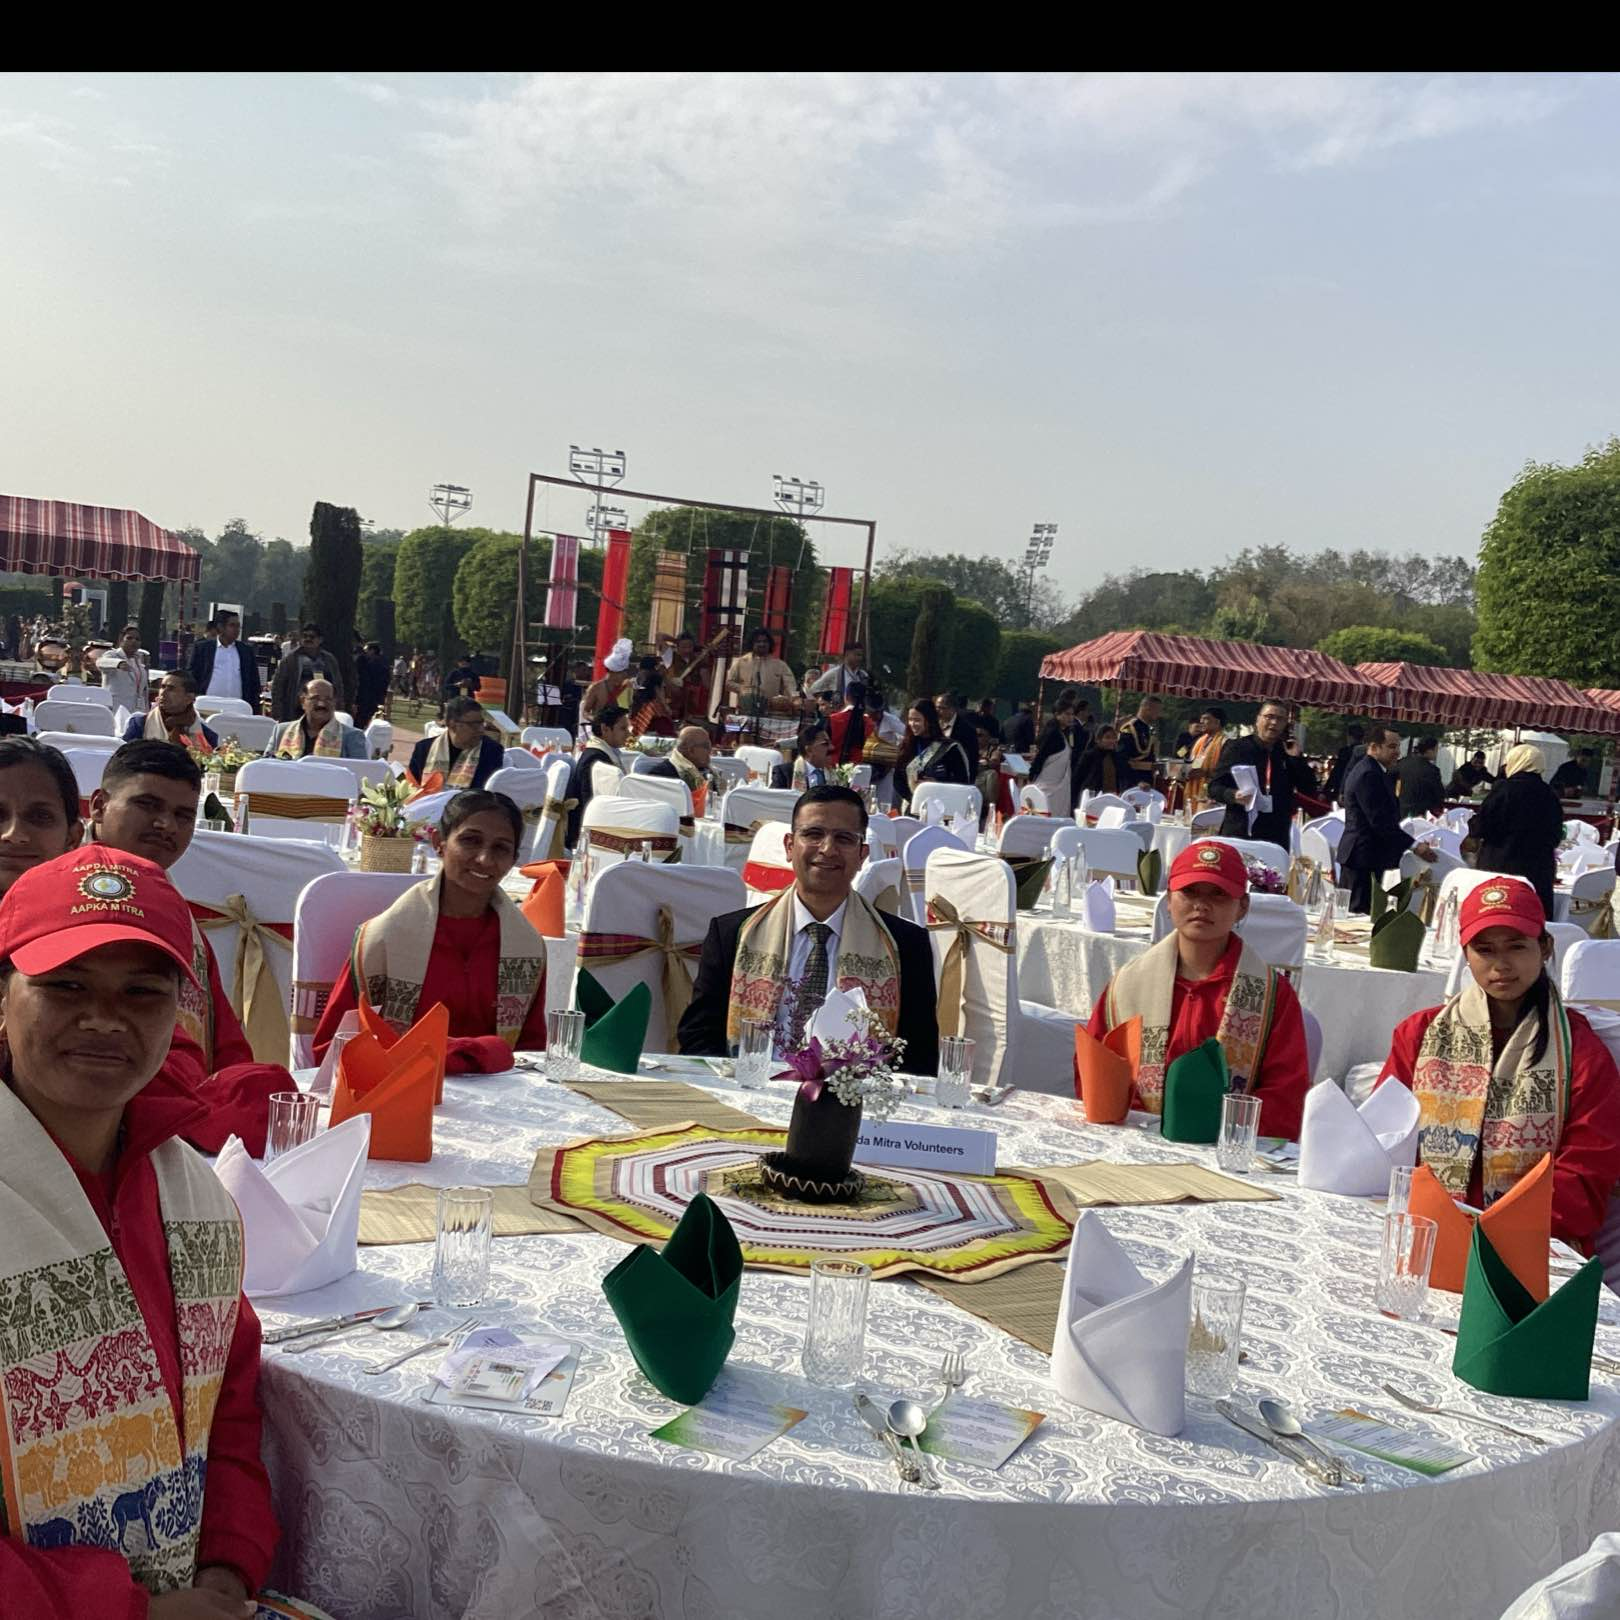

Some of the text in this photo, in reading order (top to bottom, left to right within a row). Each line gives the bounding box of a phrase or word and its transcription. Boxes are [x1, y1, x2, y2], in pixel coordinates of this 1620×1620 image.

[72, 863, 139, 877] AAPDA MITRA
[70, 903, 108, 915] AAPKA
[872, 1136, 901, 1149] Mitra
[904, 1139, 965, 1156] Volunteers
